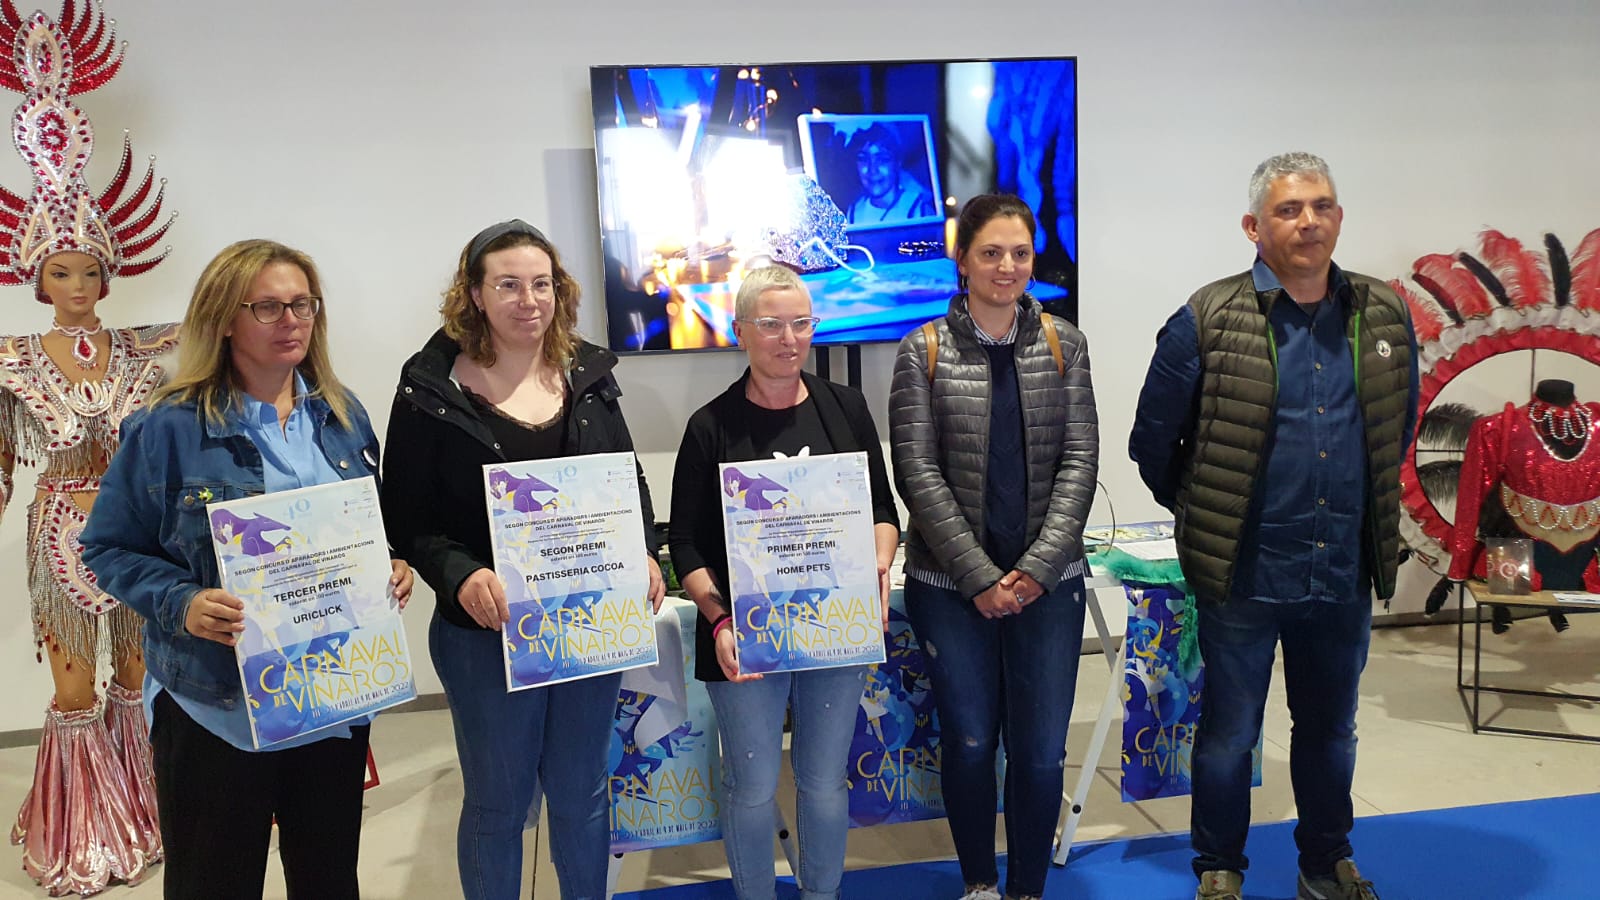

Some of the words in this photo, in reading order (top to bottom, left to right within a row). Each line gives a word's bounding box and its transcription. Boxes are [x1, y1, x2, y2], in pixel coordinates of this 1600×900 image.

[540, 545, 575, 557] SEGON
[576, 541, 606, 553] PREMI
[767, 542, 804, 553] PRIMER
[805, 540, 836, 550] PREMI
[268, 568, 280, 576] DEL
[281, 561, 312, 573] CARNAVAL
[525, 567, 590, 583] PASTISSERIA
[591, 562, 625, 573] COCOA
[776, 565, 805, 575] HOME
[806, 563, 831, 573] PETS
[273, 585, 317, 603] TERCER
[319, 577, 352, 593] PREMI
[293, 604, 343, 624] URICLICK
[517, 595, 651, 640] CARNAVAL
[746, 595, 877, 631] CARNAVAL
[529, 640, 541, 654] DE
[757, 632, 768, 643] DE
[259, 629, 403, 694] CARNAVAL
[391, 681, 409, 693] 2022
[273, 692, 288, 708] DE
[857, 745, 943, 779] CARN
[608, 766, 716, 803] RNAVAL
[867, 780, 879, 793] DE
[880, 776, 943, 803] VINA
[609, 795, 720, 831] INAROS
